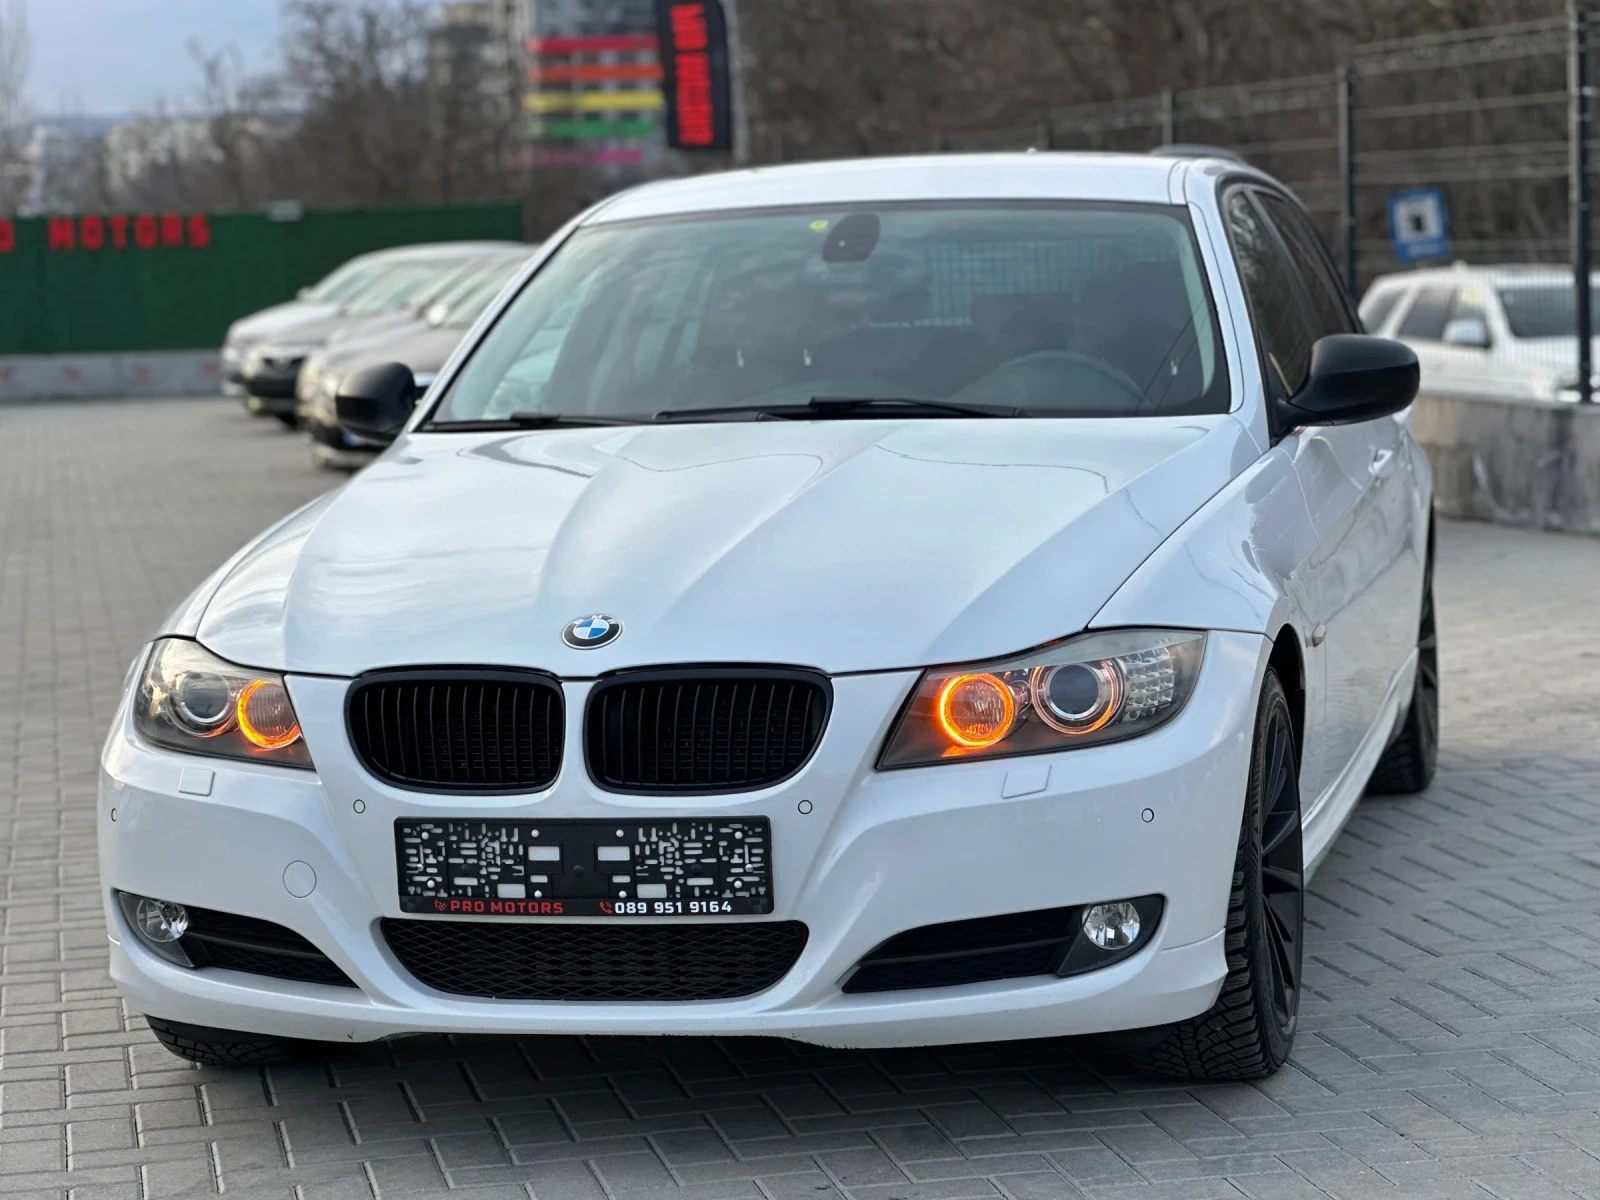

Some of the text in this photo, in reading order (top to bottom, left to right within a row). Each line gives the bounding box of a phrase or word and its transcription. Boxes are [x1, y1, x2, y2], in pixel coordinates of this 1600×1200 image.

[48, 213, 210, 249] MOTORS
[450, 900, 564, 914] PRO MOTORS
[614, 901, 732, 914] 089 951 9164
